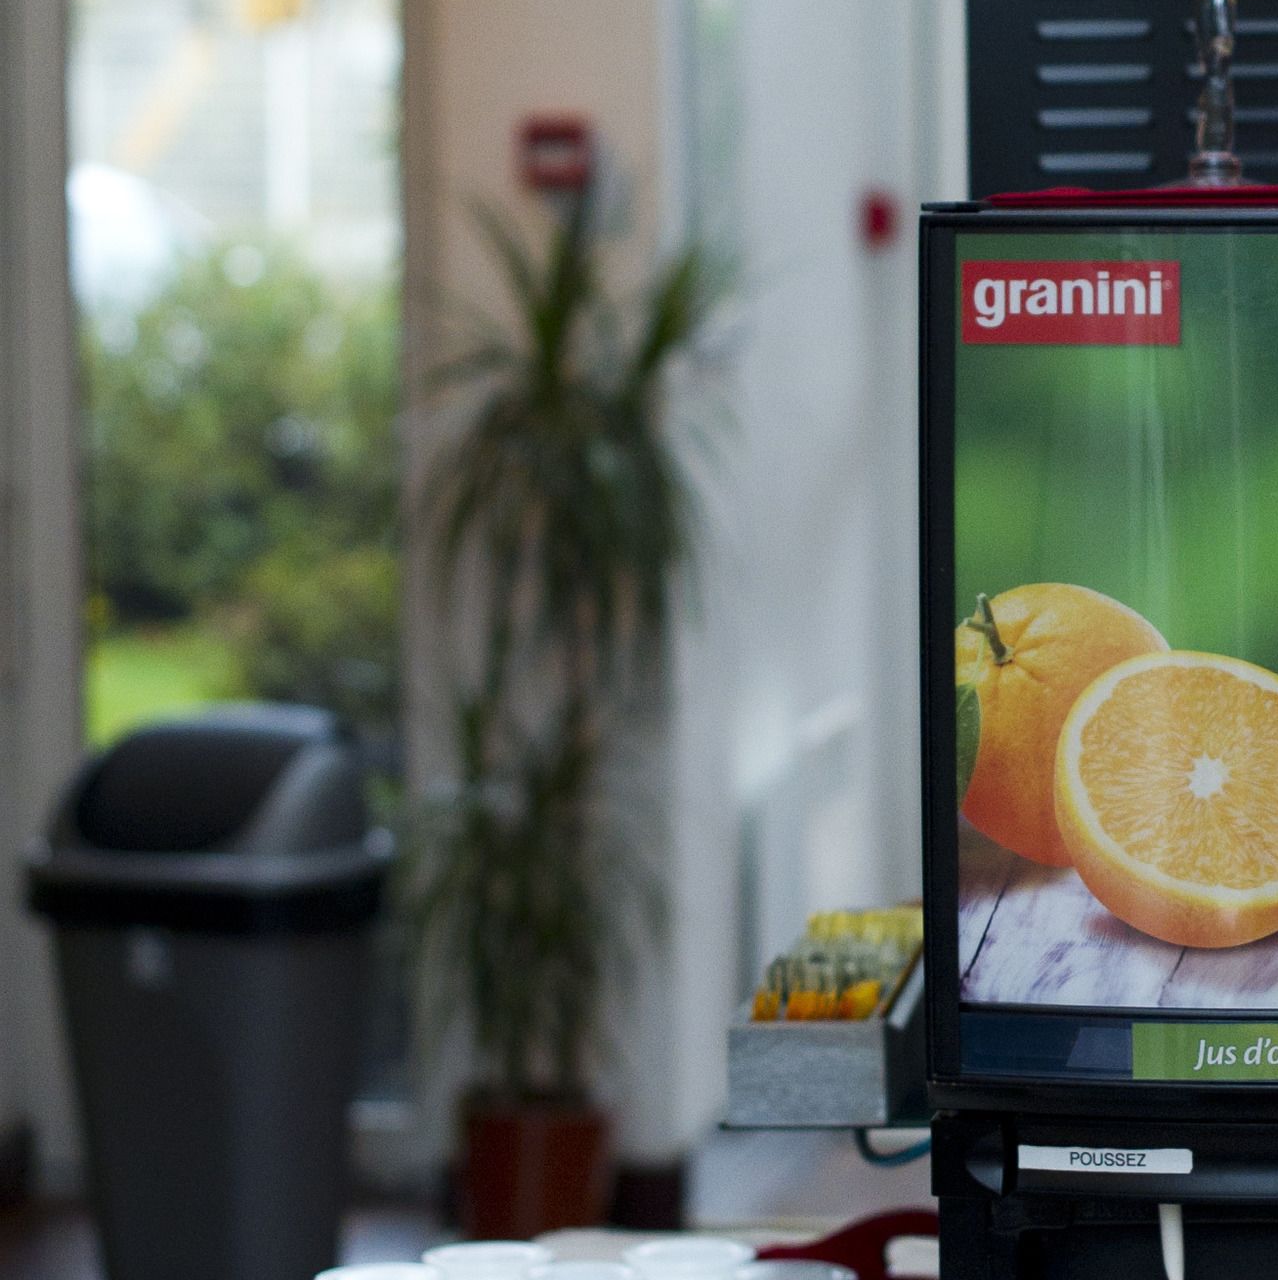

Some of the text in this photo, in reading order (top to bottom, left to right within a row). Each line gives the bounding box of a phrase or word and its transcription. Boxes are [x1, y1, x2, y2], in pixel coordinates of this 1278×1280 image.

[973, 270, 1163, 328] granini
[1193, 1039, 1237, 1071] Jus
[1069, 1151, 1147, 1167] POUSSEZ
